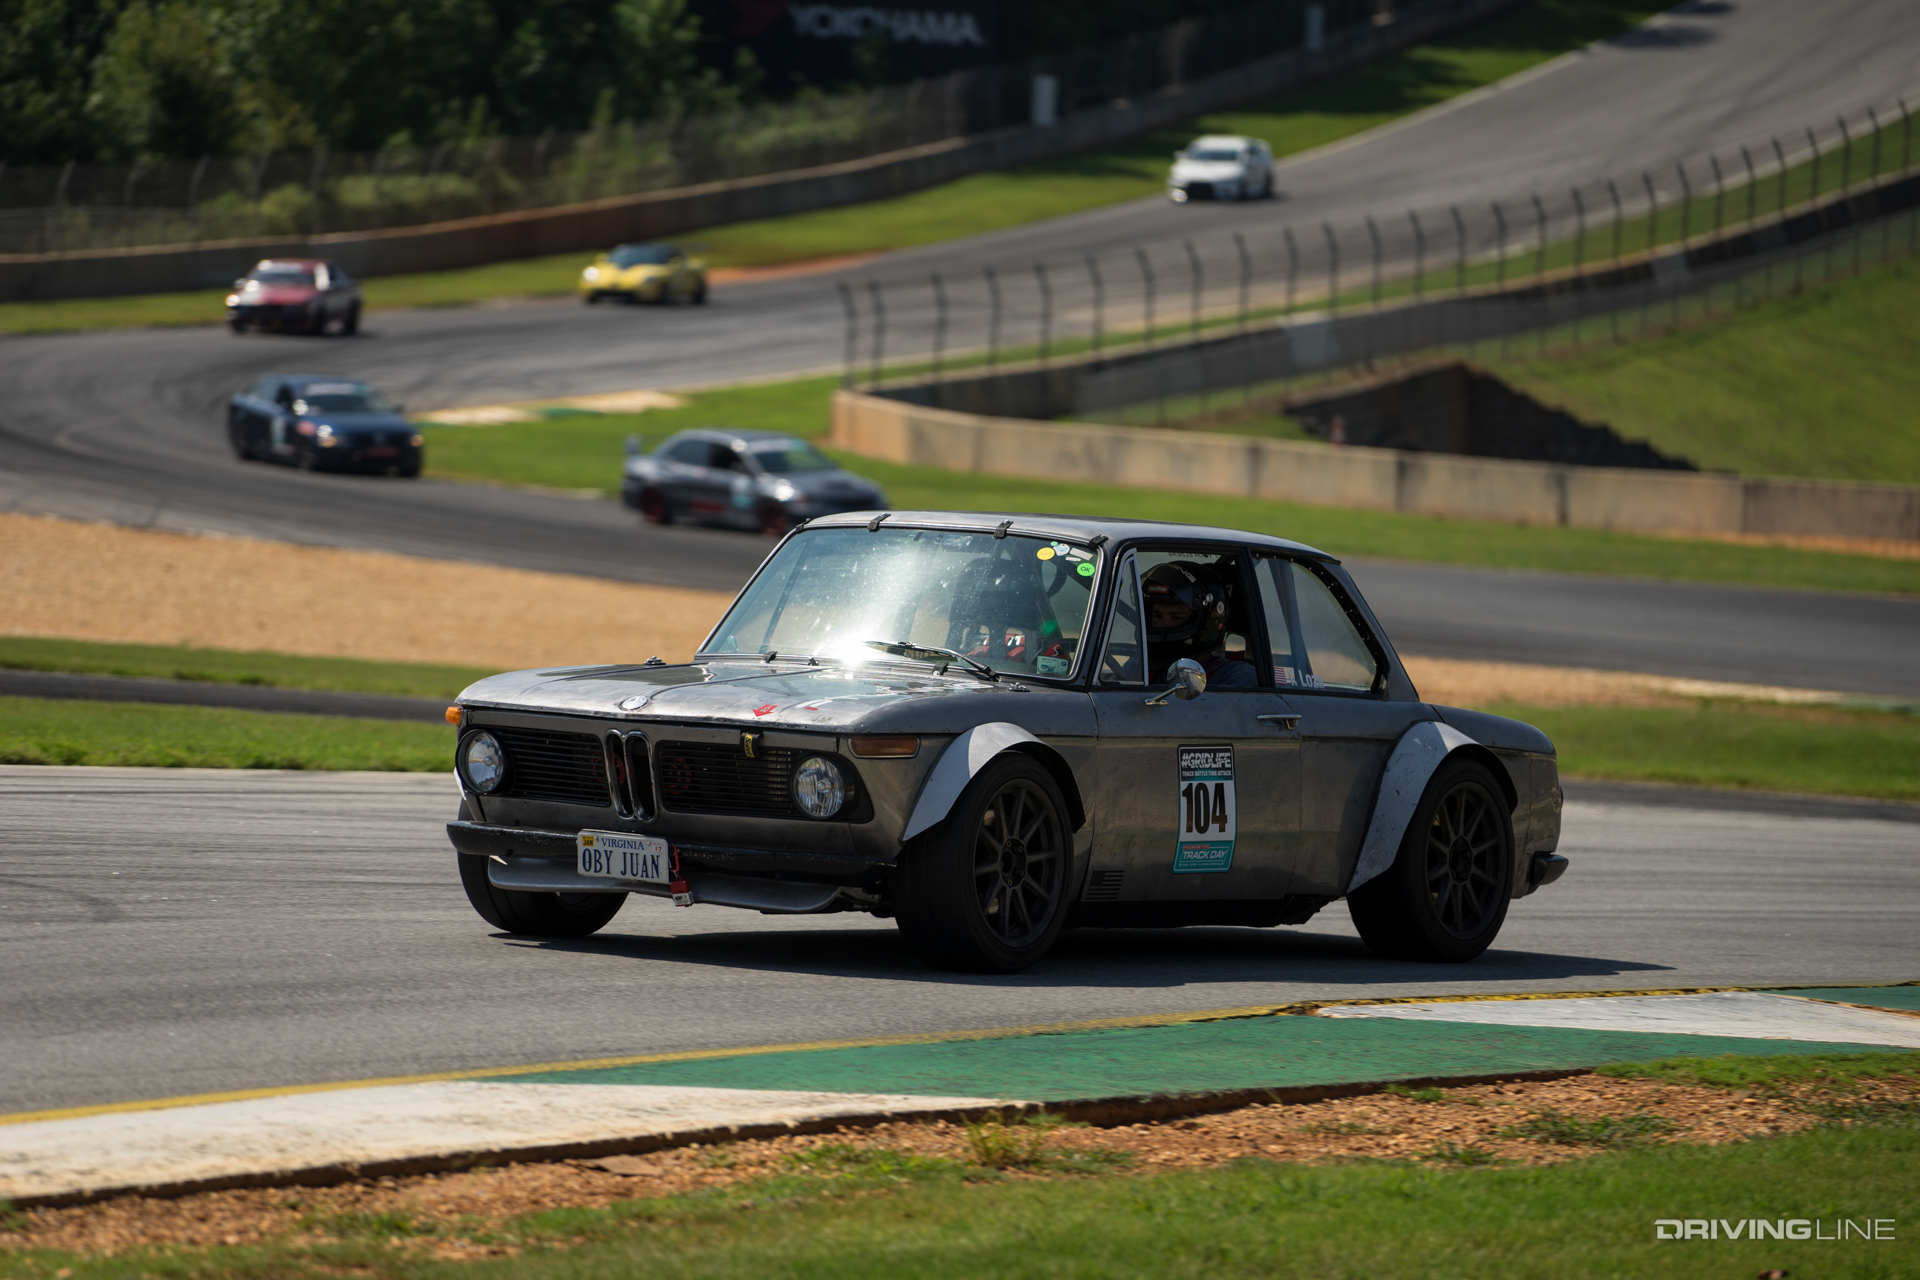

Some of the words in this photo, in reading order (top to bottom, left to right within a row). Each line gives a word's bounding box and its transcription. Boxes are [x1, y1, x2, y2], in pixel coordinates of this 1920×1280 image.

[1181, 752, 1232, 769] #GRIDLIFE
[1181, 782, 1228, 835] 104
[600, 838, 645, 850] VIRGINIA
[1183, 850, 1210, 859] TRACK
[1209, 850, 1227, 859] DAY
[582, 848, 613, 874] OBY
[621, 852, 660, 879] JUAN
